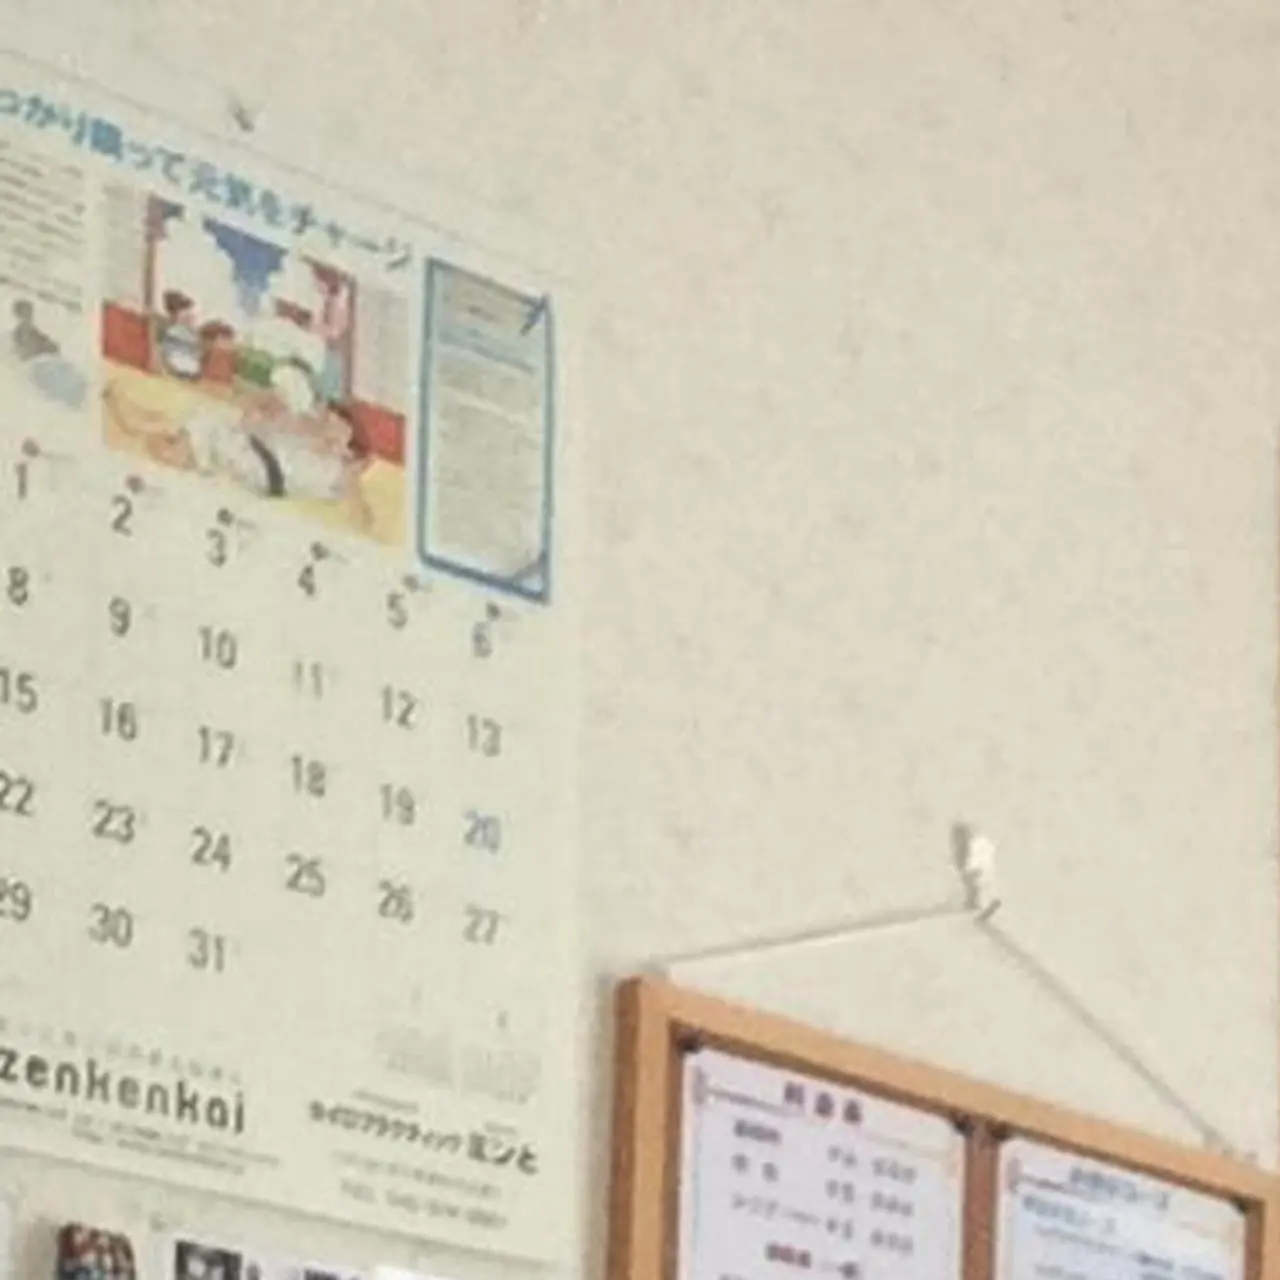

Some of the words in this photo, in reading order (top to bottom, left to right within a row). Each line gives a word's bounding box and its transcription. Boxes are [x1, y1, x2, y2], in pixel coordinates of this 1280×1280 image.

[110, 496, 133, 535] 2
[205, 530, 228, 568] 3
[297, 562, 317, 596] 4
[388, 592, 408, 629] 5
[8, 566, 29, 606] 8
[109, 598, 132, 637] 9
[199, 627, 238, 669] 10
[294, 662, 323, 699] 11
[381, 686, 416, 729] 12
[467, 715, 502, 757] 13
[0, 667, 38, 714] 15
[102, 698, 137, 741] 16
[199, 726, 235, 768] 17
[292, 756, 327, 798] 18
[381, 784, 416, 826] 19
[464, 811, 501, 853] 20
[88, 903, 134, 948] 30
[187, 928, 225, 973] 31
[92, 799, 135, 843] 23
[191, 828, 232, 872] 24
[286, 853, 326, 897] 25
[378, 881, 415, 924] 26
[463, 906, 500, 946] 27
[0, 1047, 246, 1135] zenkenkai
